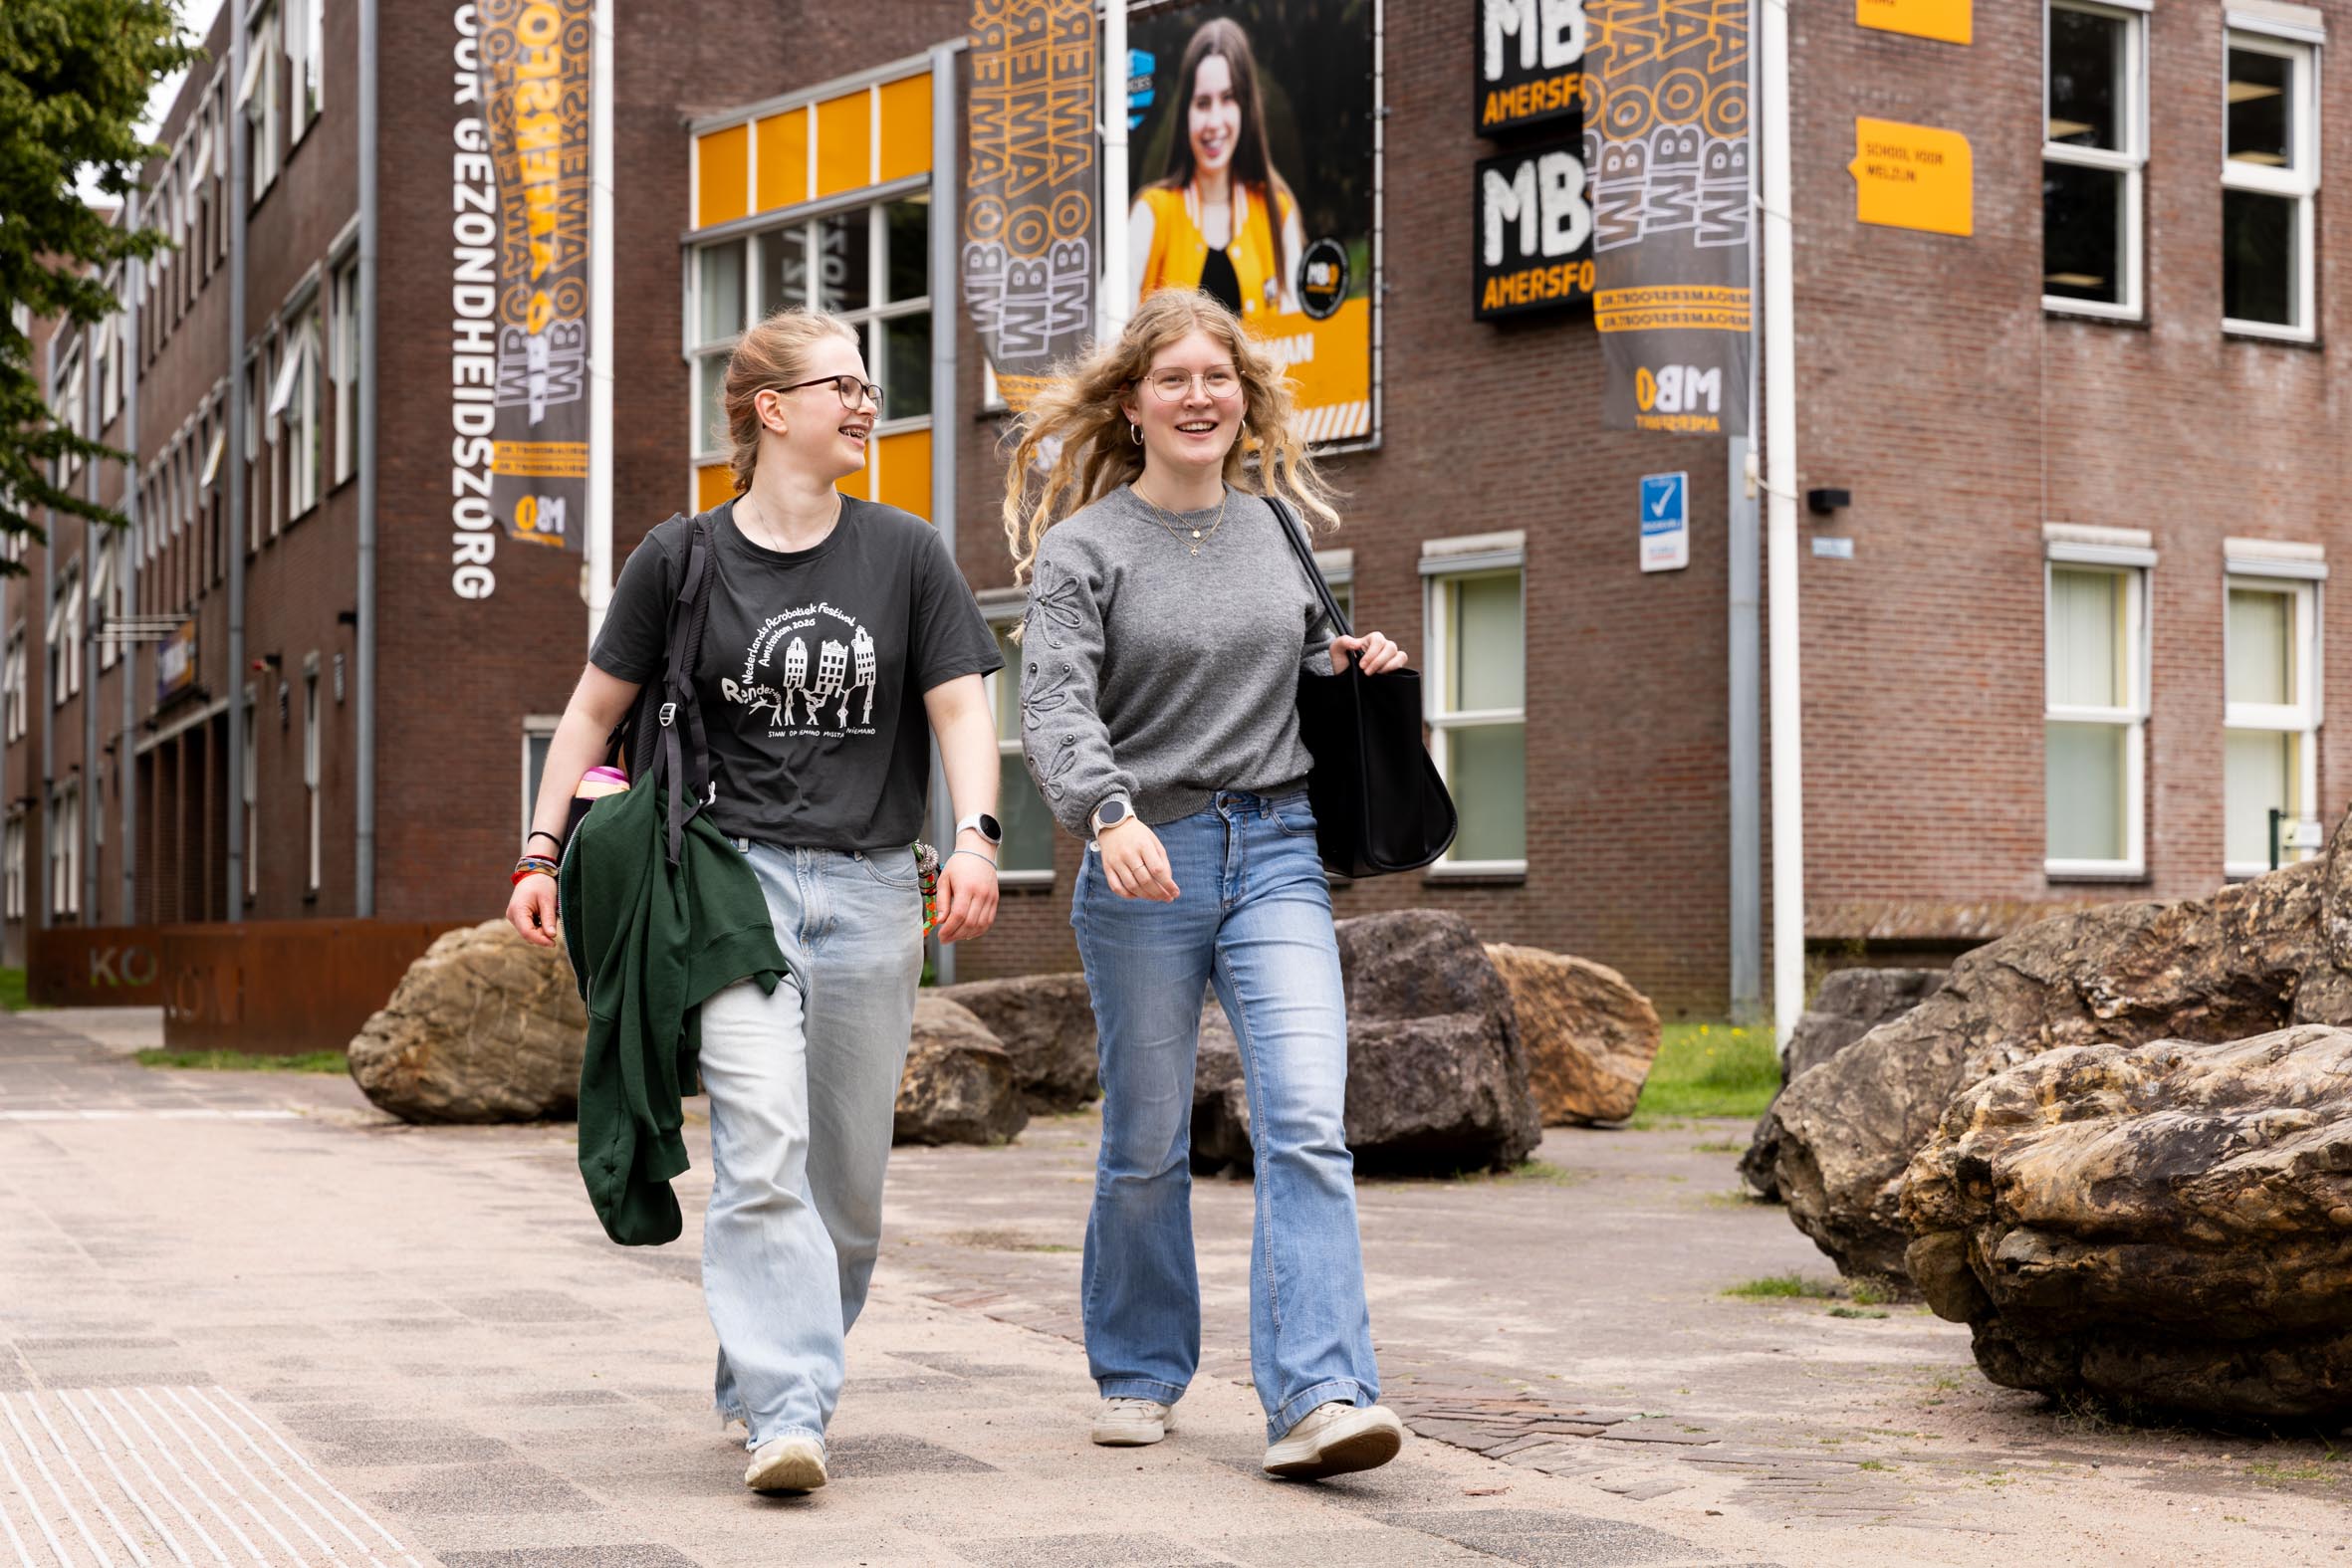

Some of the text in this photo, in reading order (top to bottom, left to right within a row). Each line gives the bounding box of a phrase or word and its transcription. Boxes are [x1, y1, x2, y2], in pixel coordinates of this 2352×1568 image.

[1482, 72, 1585, 126] AMERSF
[1483, 151, 1593, 266] MB
[453, 117, 496, 599] GEZONDHEIDSZORG
[742, 601, 856, 685] Nederlands Acrobatiek Festival
[758, 625, 794, 667] Amsterdam
